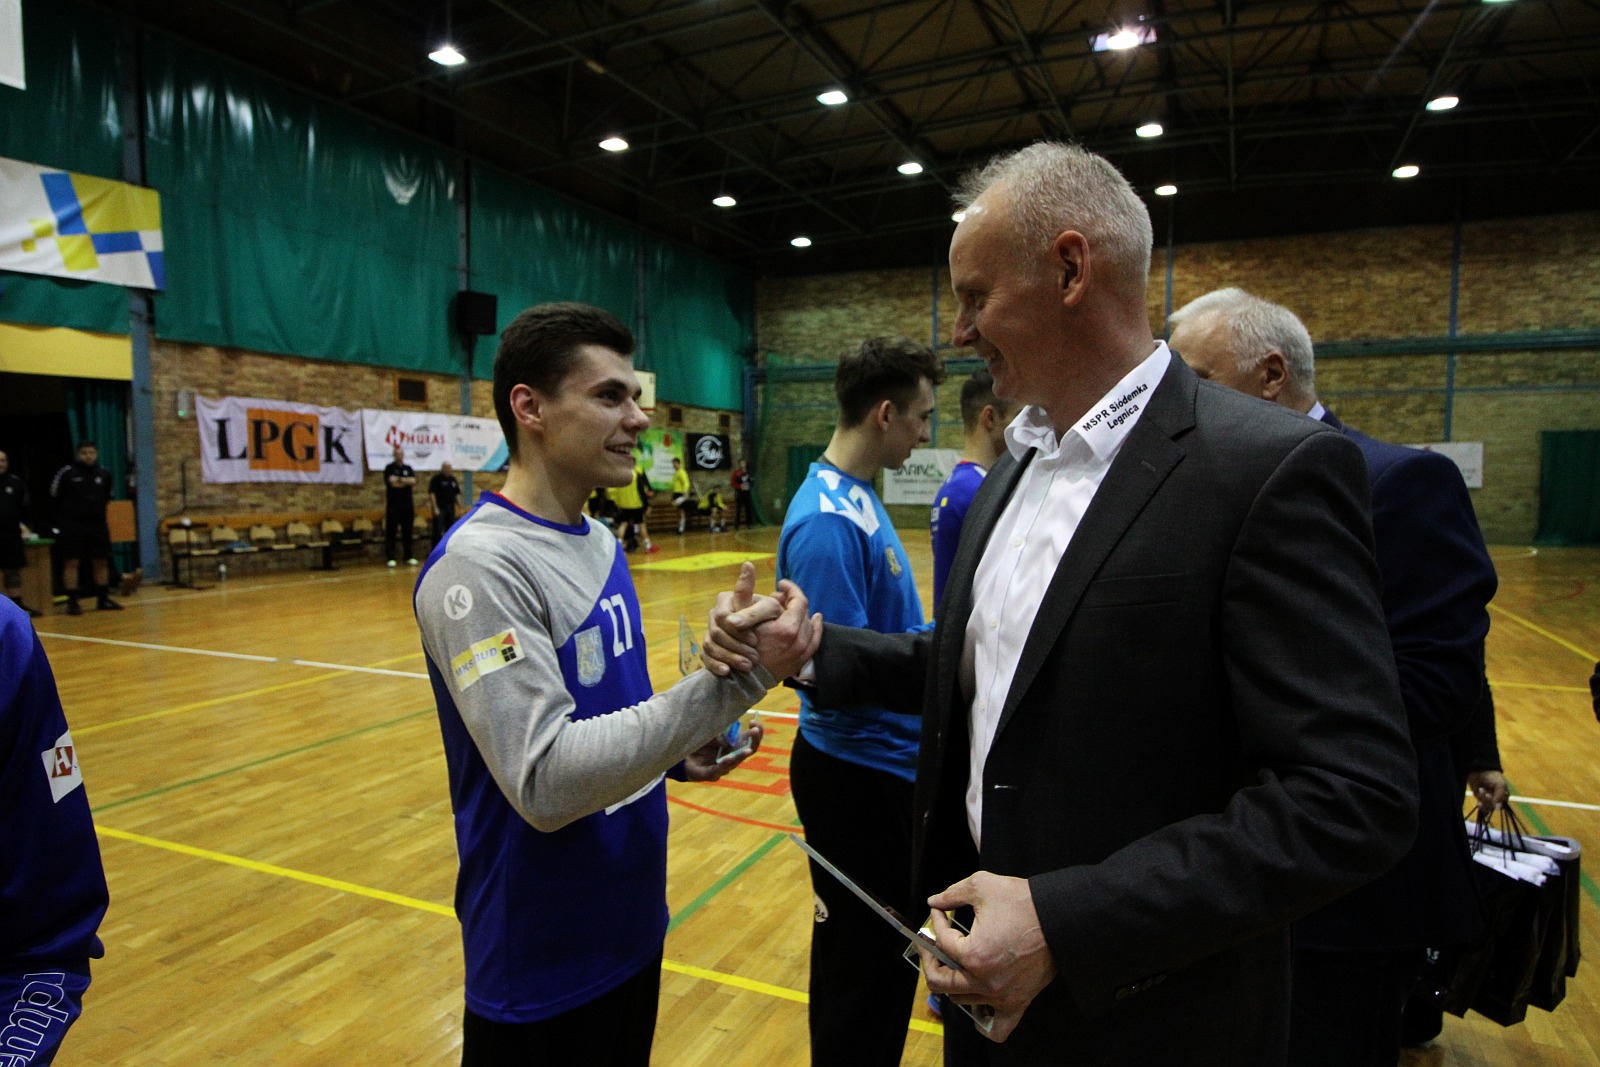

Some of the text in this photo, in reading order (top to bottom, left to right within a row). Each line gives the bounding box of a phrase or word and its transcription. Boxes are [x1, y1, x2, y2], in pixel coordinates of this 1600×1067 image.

[1082, 383, 1148, 431] MSPR Siódemka
[1106, 404, 1139, 429] Legnica
[213, 418, 353, 465] LPGK
